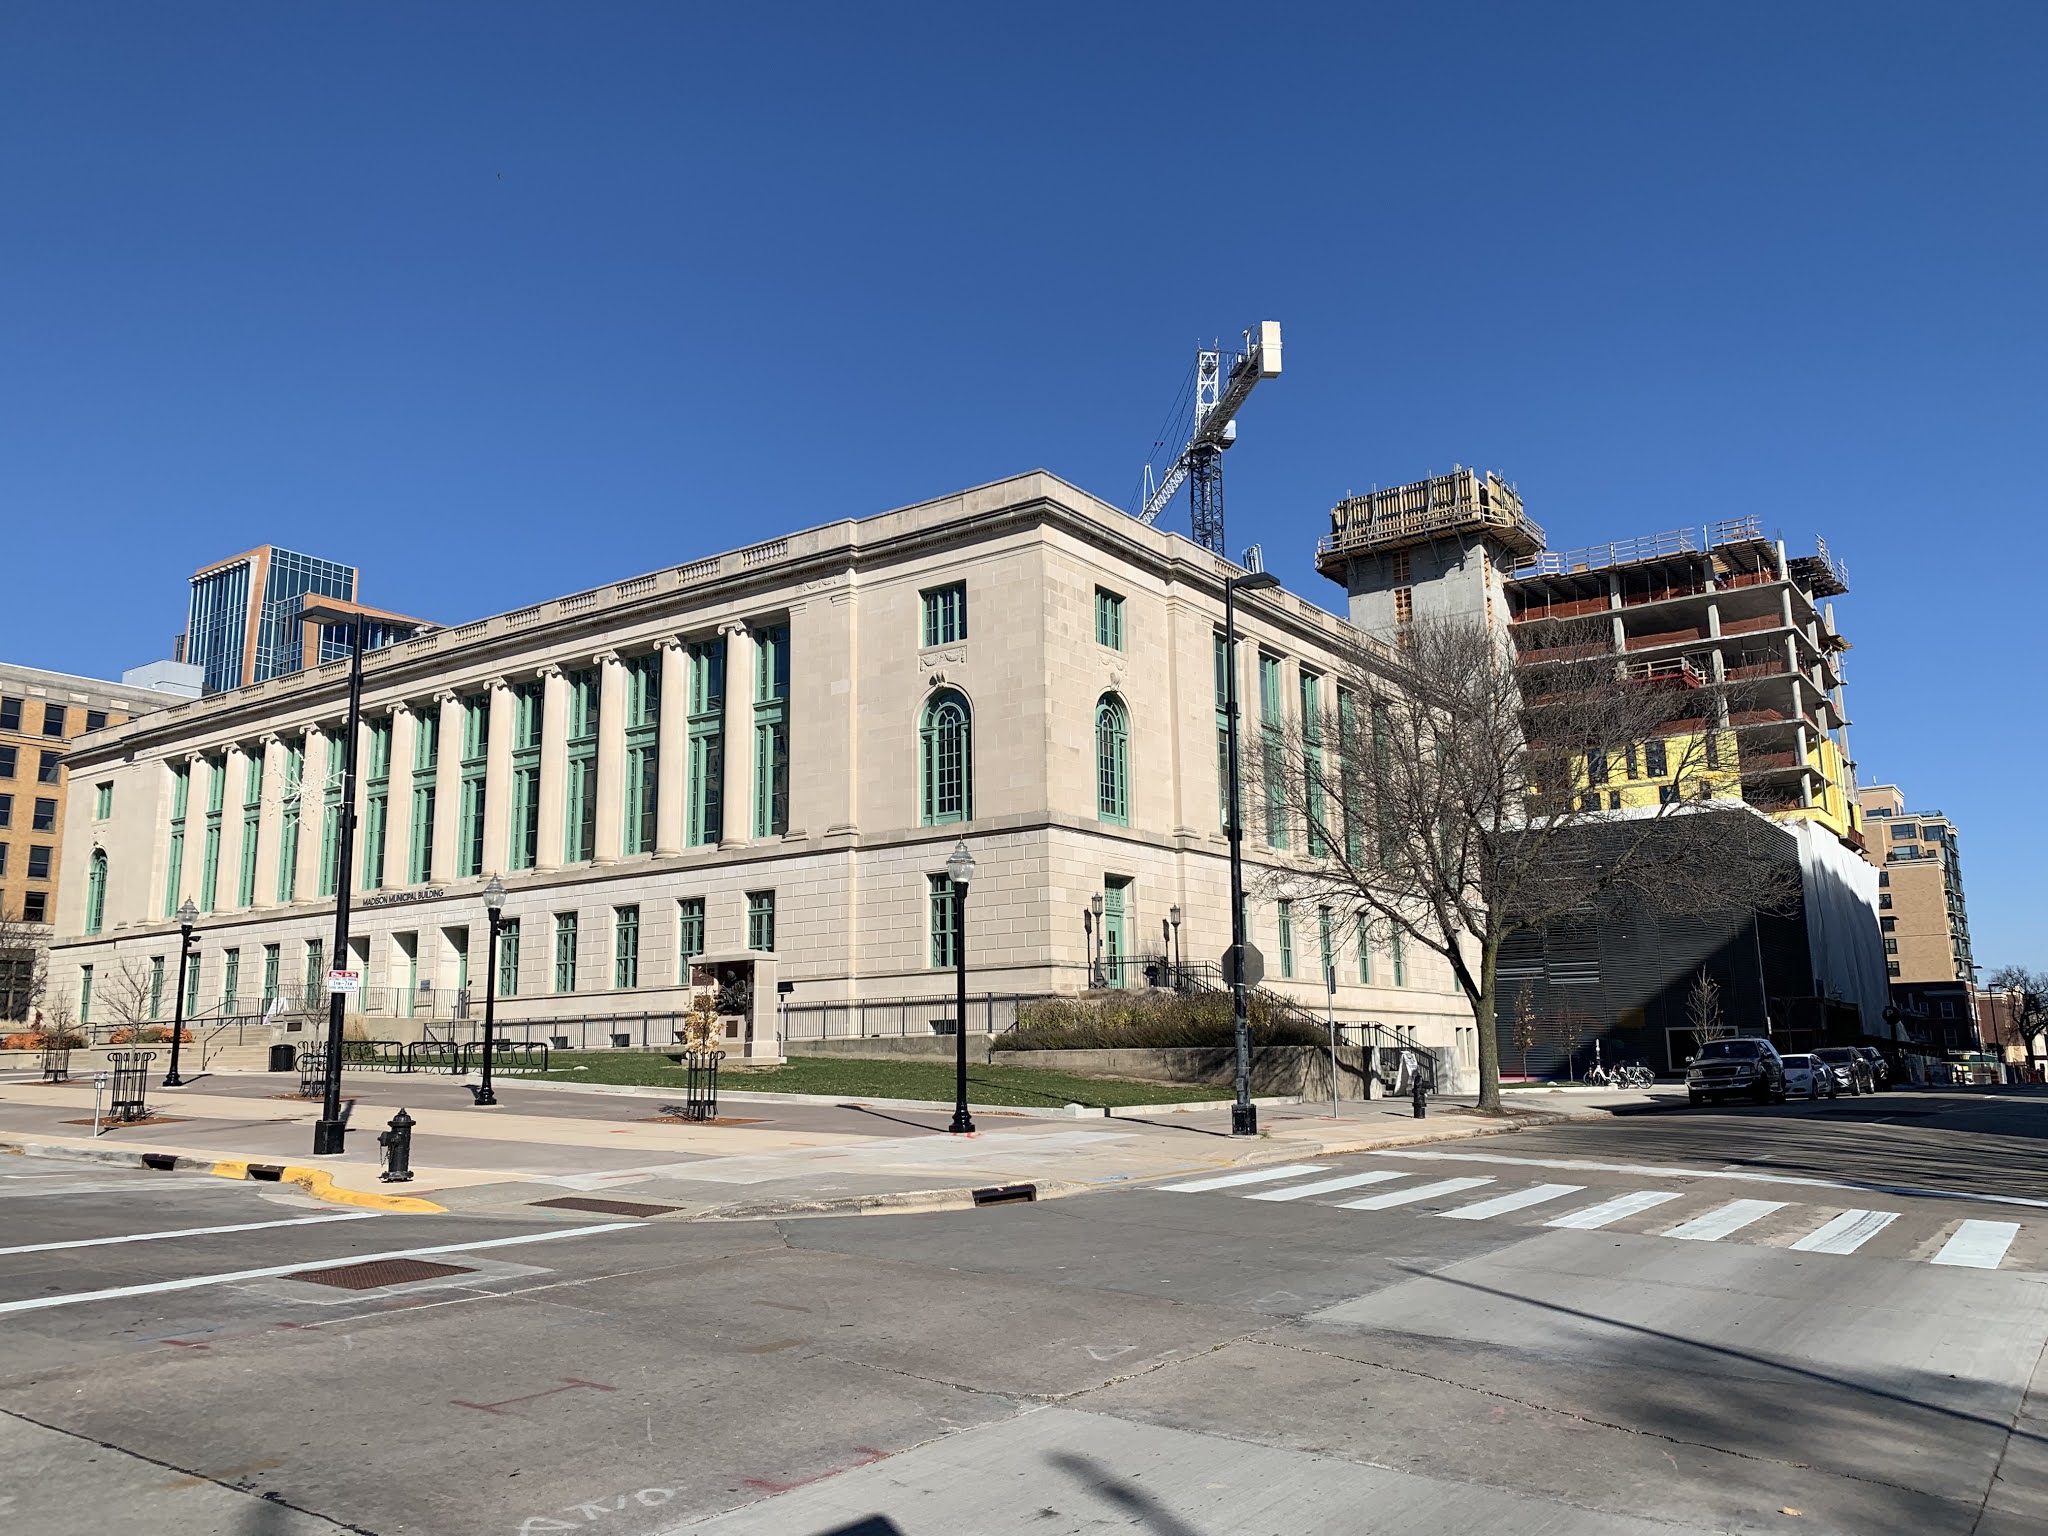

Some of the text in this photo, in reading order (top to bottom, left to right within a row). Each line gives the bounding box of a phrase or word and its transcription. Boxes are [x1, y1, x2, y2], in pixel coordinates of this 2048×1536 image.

[362, 889, 444, 906] MADISON MUNICIPAL BUILDING
